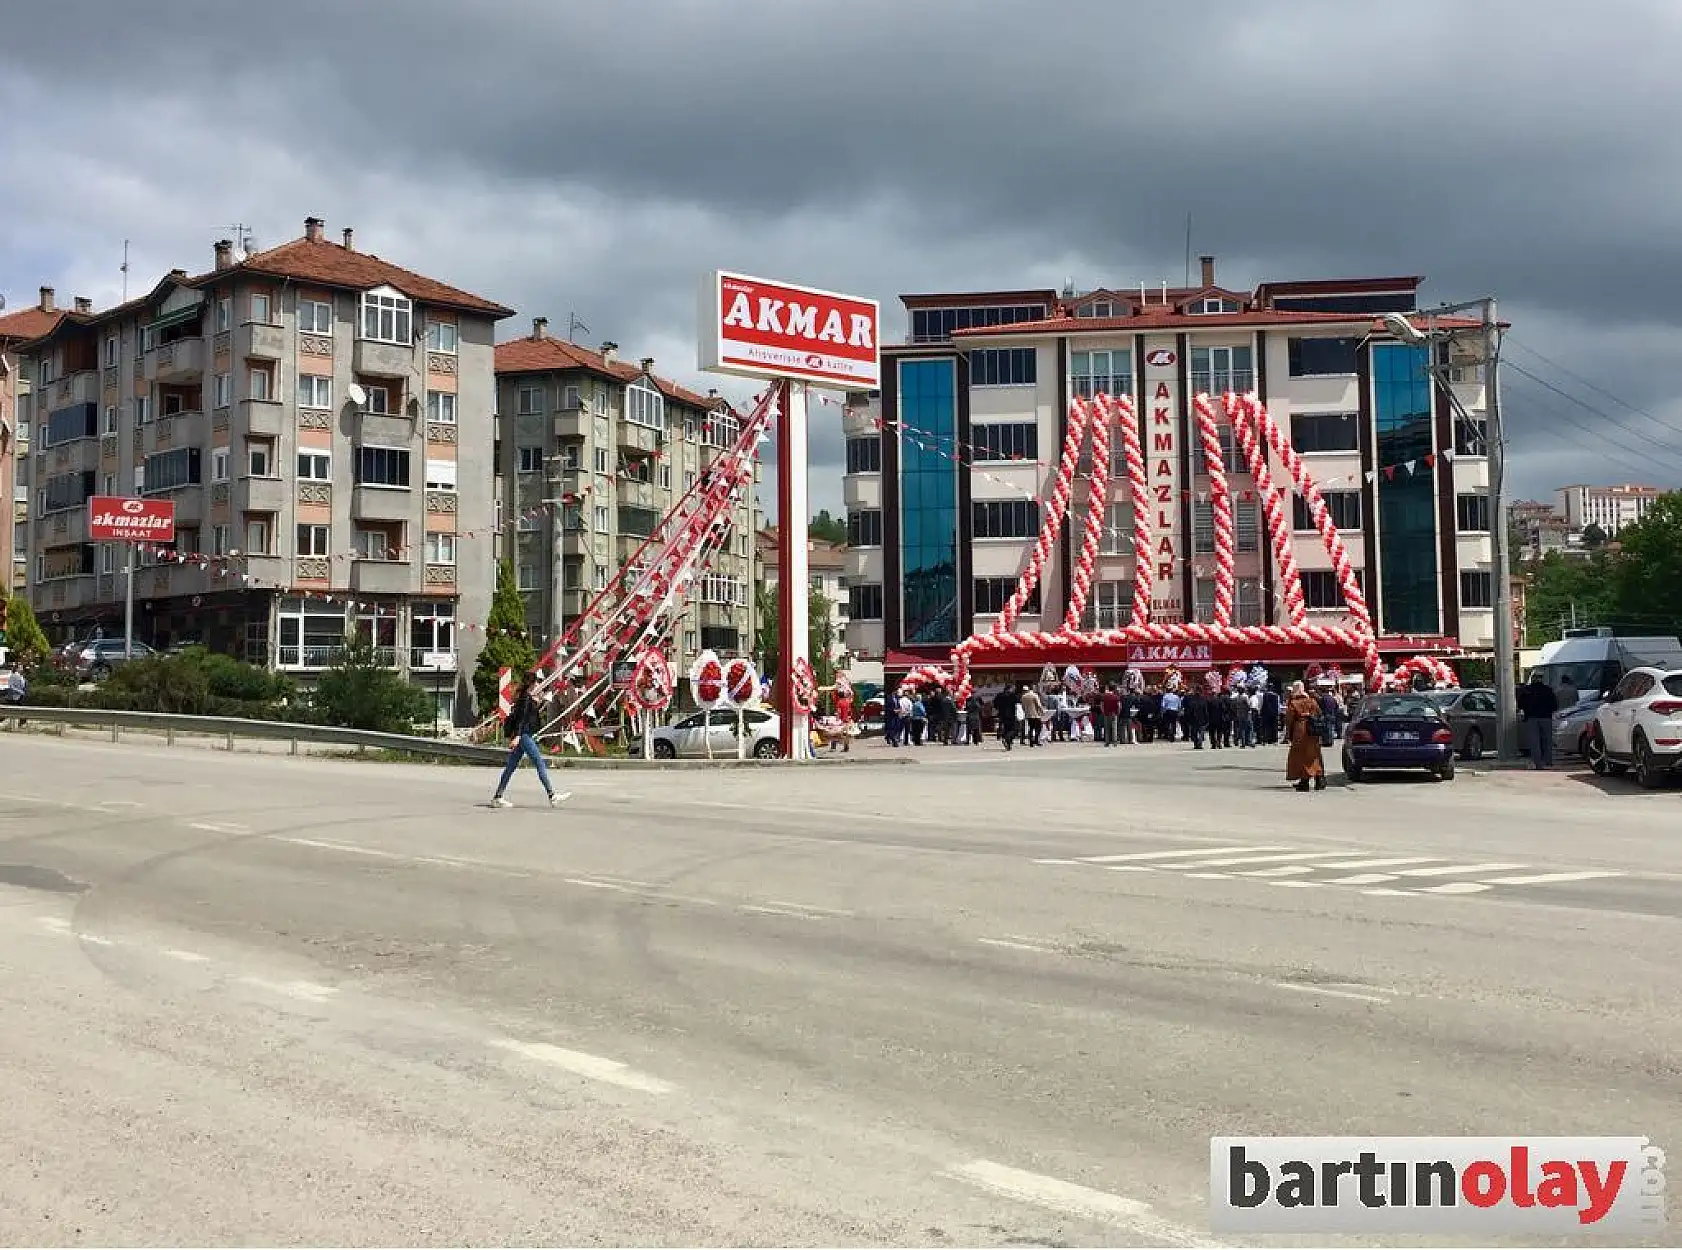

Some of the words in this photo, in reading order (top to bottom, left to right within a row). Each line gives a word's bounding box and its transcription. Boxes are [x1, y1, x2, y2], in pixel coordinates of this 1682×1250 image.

[723, 291, 873, 349] AKMAR
[1154, 381, 1174, 581] AKMAZLAR
[91, 511, 172, 529] akmazlar
[1129, 645, 1210, 660] AKMAR
